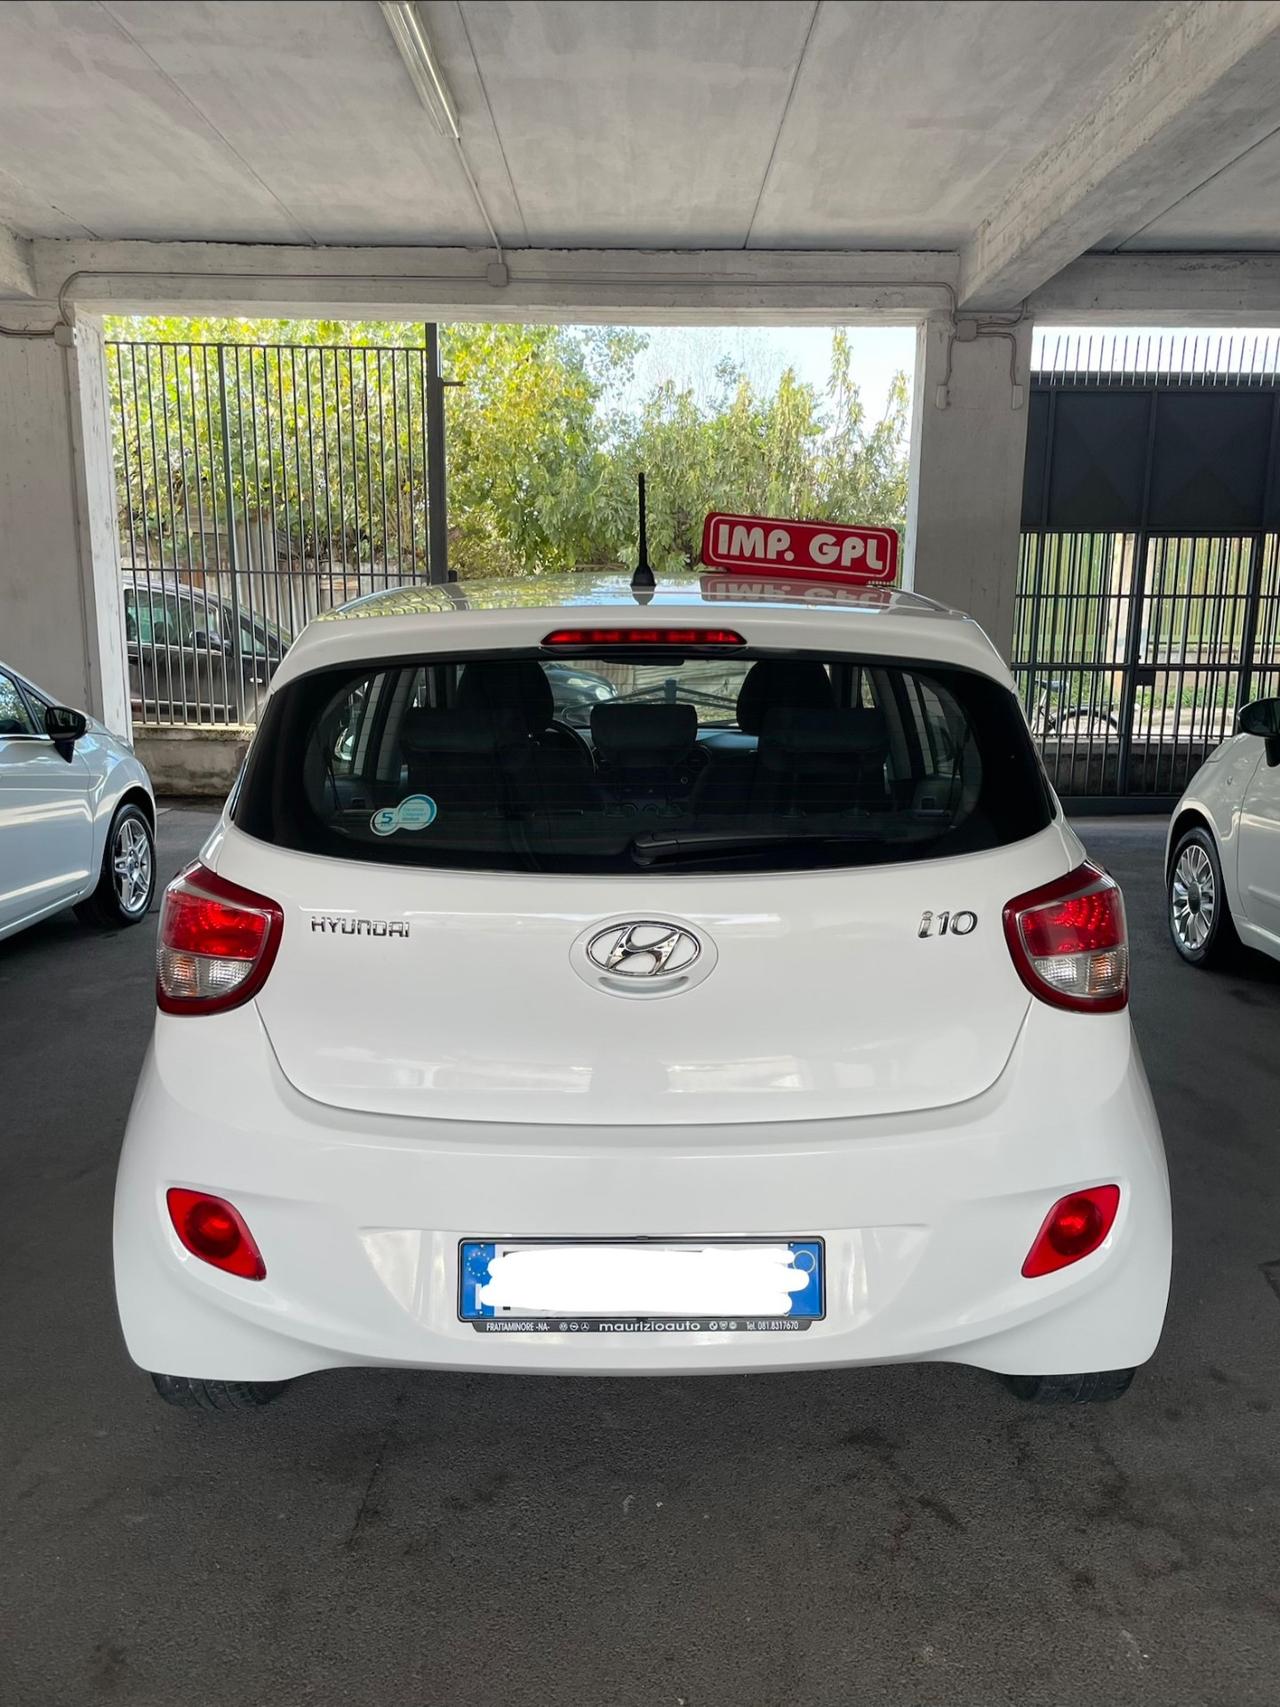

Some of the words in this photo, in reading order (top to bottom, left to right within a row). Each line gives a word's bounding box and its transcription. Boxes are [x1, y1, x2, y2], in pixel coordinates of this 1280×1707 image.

[717, 524, 795, 562] IMP.
[809, 533, 883, 570] GPL
[381, 811, 394, 824] 5
[311, 916, 410, 938] HYUNDAI
[918, 910, 978, 938] i10
[486, 1322, 534, 1332] FRATTAMINORE
[599, 1321, 700, 1331] maurizioauto
